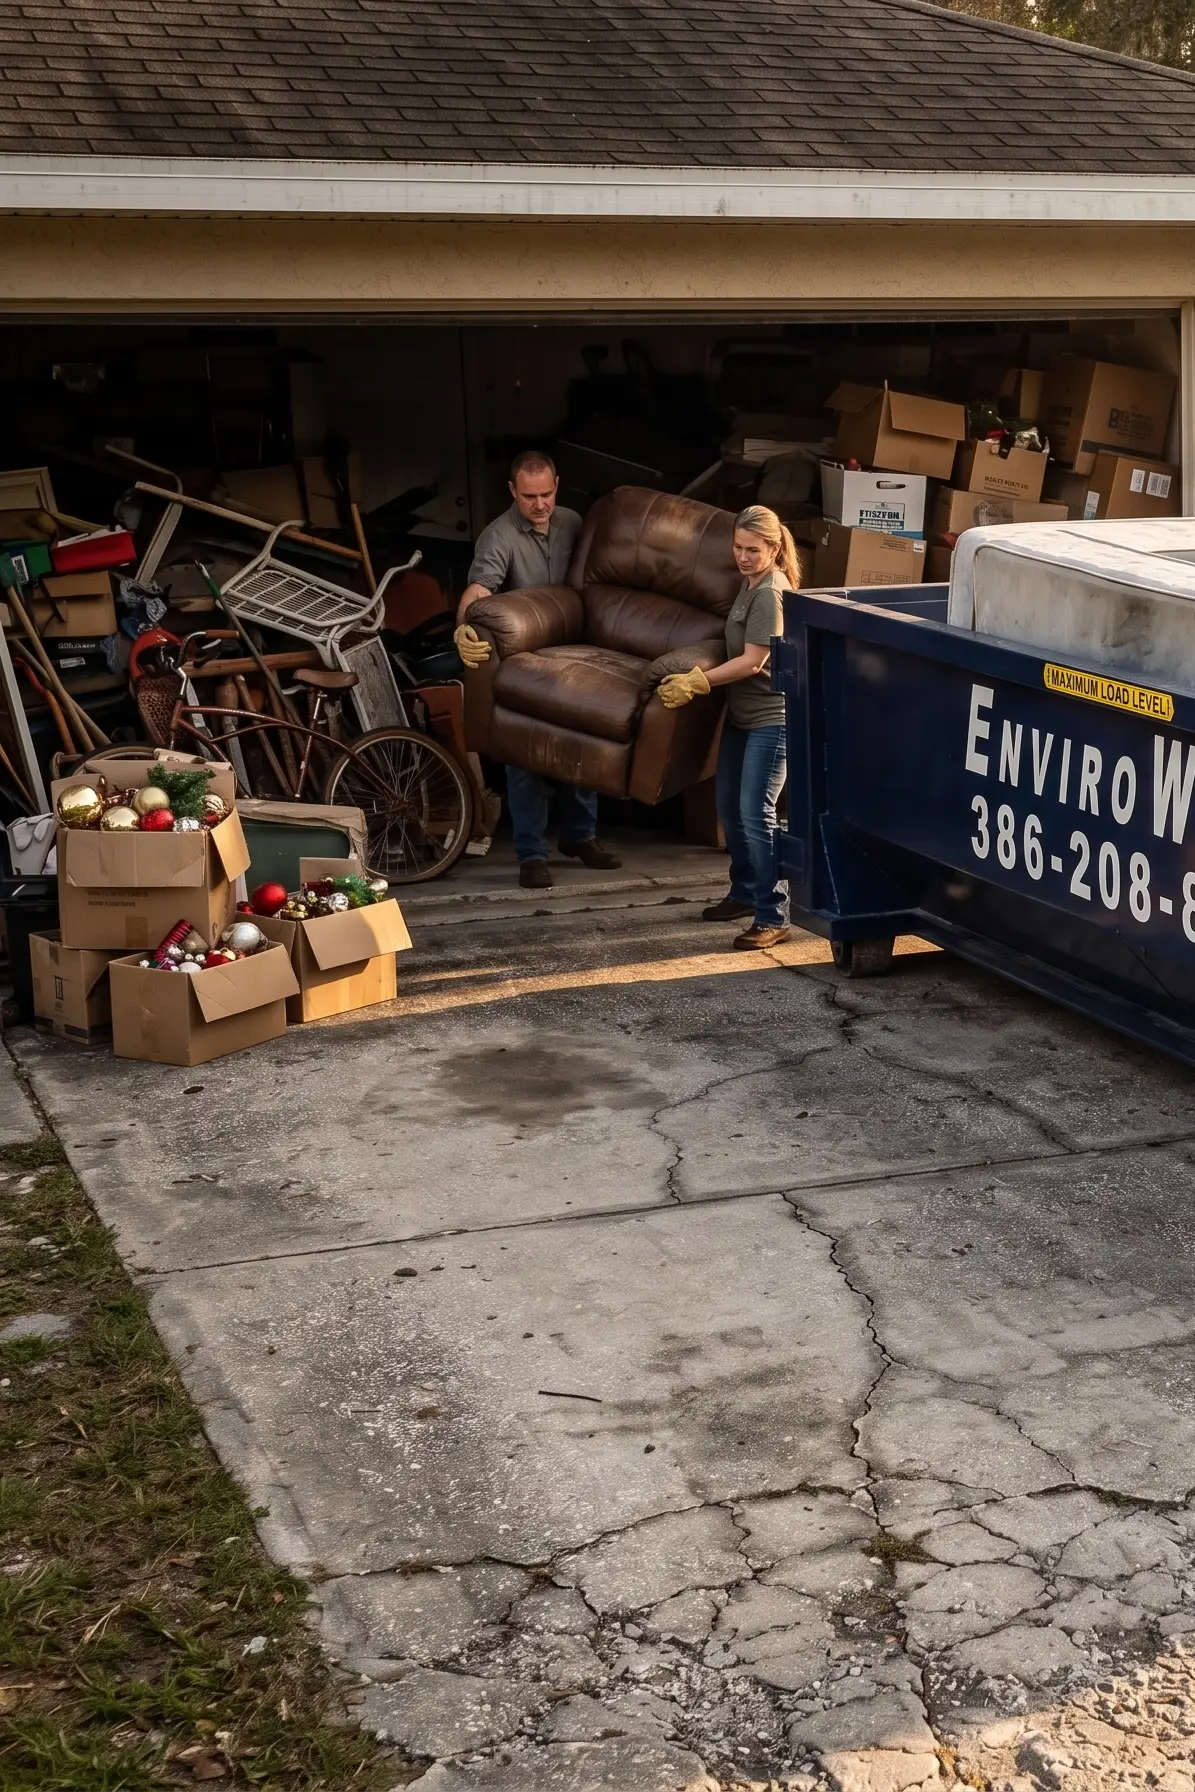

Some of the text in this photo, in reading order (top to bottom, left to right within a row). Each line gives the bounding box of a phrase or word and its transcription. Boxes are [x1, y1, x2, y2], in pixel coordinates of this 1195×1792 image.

[1051, 668, 1099, 698] MAXIMUM
[1101, 682, 1130, 705] LOAD
[1132, 690, 1166, 716] LEVEL
